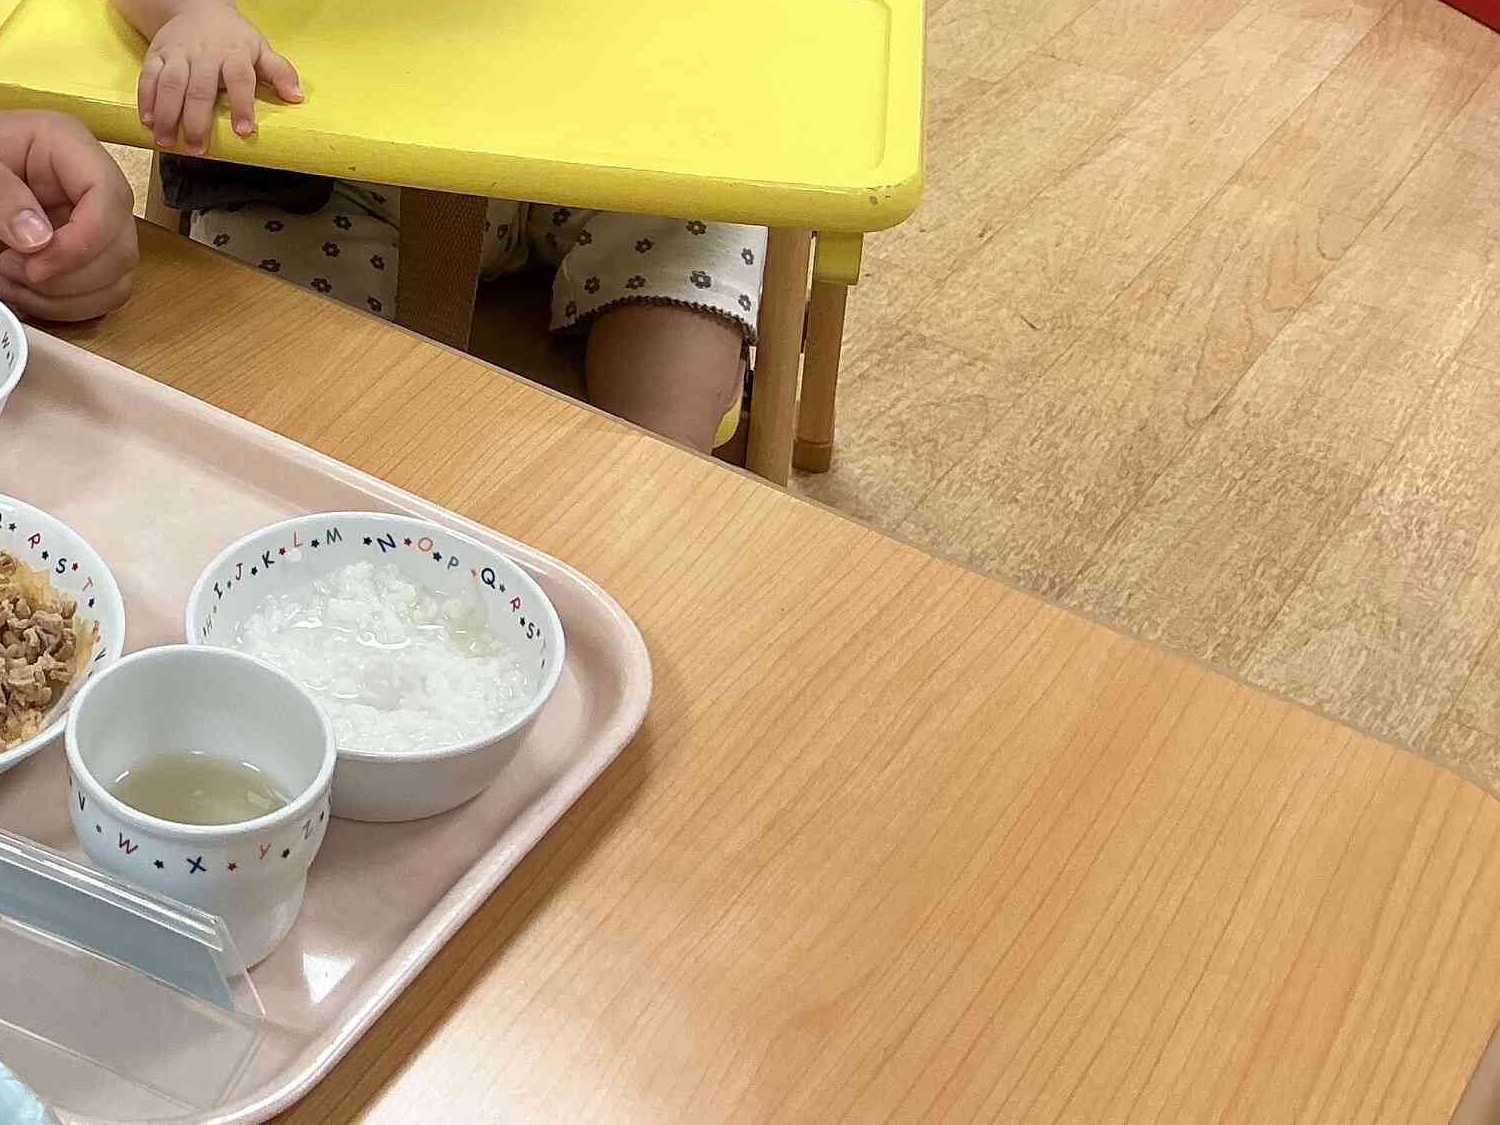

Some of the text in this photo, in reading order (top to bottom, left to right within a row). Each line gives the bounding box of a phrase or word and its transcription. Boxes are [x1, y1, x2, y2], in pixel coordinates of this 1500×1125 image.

[27, 532, 42, 550] R
[54, 557, 69, 575] S
[82, 576, 94, 592] T
[213, 582, 224, 600] I
[234, 562, 245, 581] J
[261, 550, 275, 568] K
[293, 530, 304, 549] L
[325, 527, 343, 544] M
[376, 533, 397, 553] N
[418, 536, 434, 552] O
[447, 555, 460, 571] P
[480, 567, 497, 591] Q
[510, 596, 522, 613] R
[526, 621, 536, 640] S
[77, 789, 86, 811] V
[119, 832, 139, 855] W
[186, 855, 207, 874] X
[259, 842, 272, 860] Y
